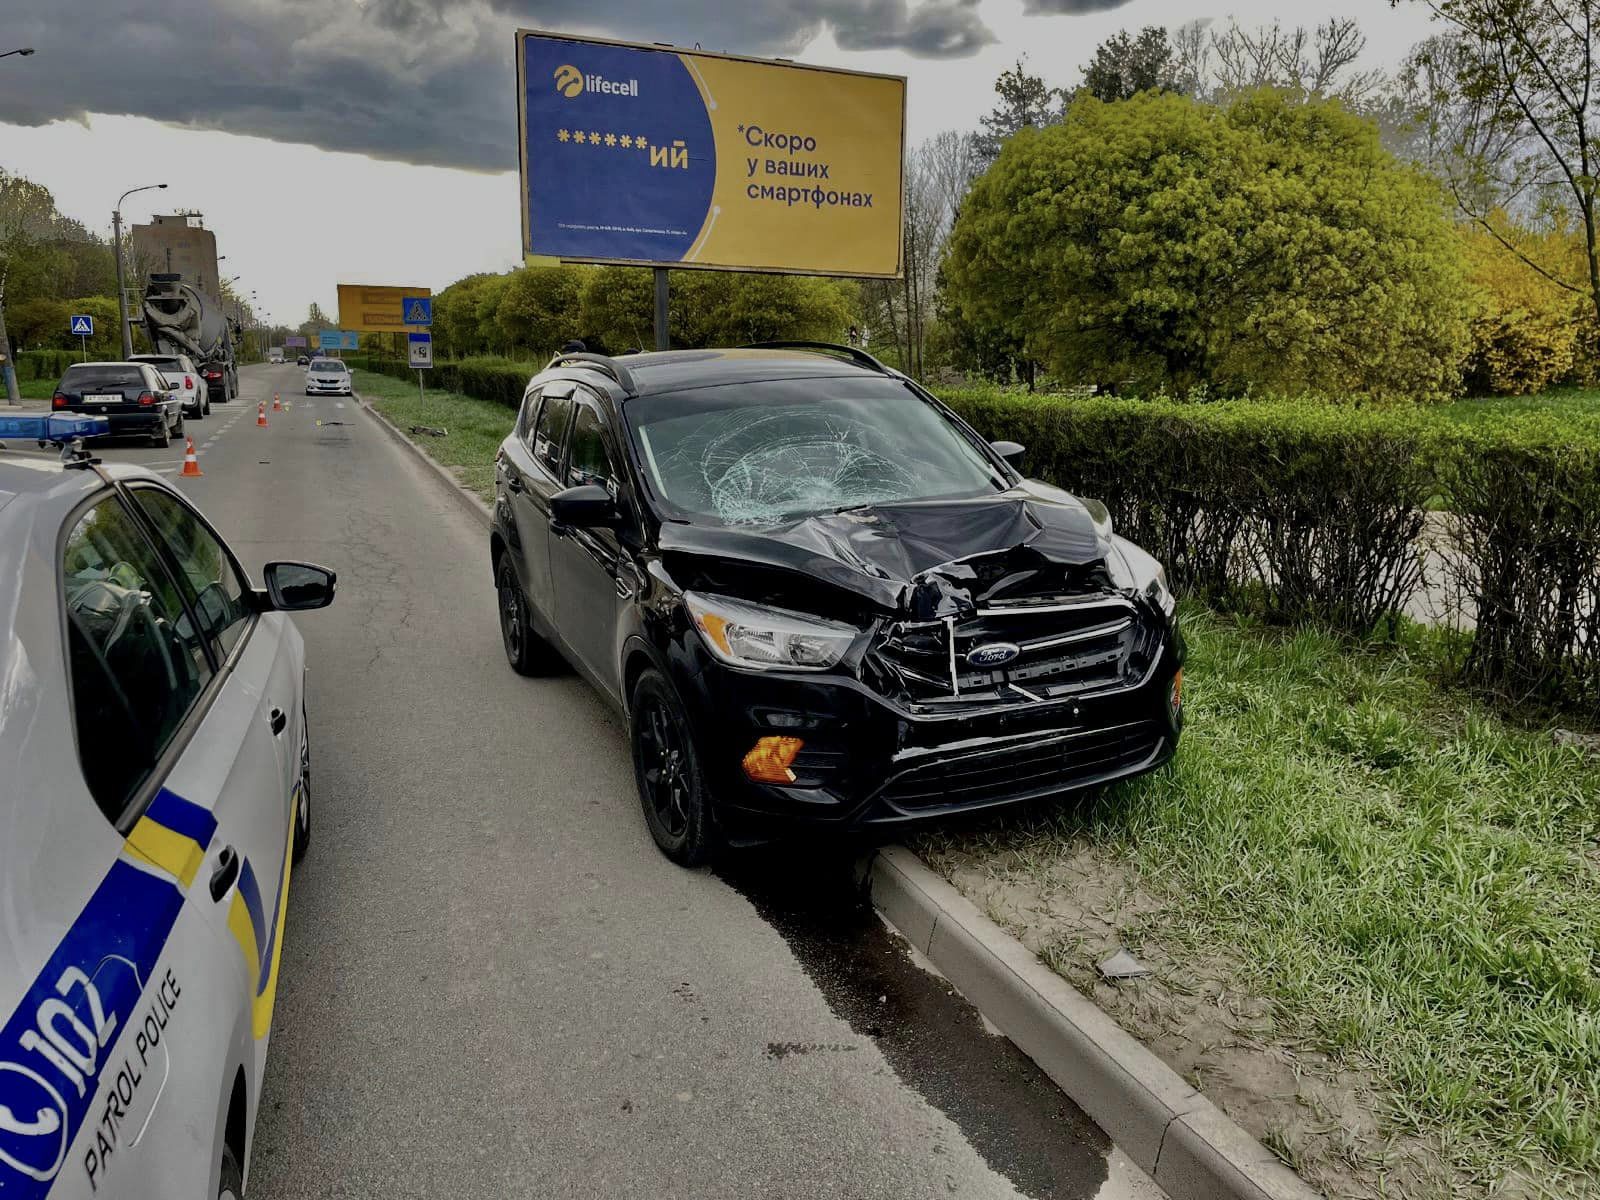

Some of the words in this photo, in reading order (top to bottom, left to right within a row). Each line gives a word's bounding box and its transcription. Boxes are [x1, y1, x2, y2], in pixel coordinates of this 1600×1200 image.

[585, 74, 638, 97] lifecell
[747, 158, 758, 177] у
[765, 159, 829, 179] ваших
[747, 184, 873, 209] смартфонах
[980, 649, 1007, 661] Ford
[19, 966, 118, 1099] 102
[83, 1058, 142, 1192] PATROL
[135, 969, 182, 1067] POLICE
